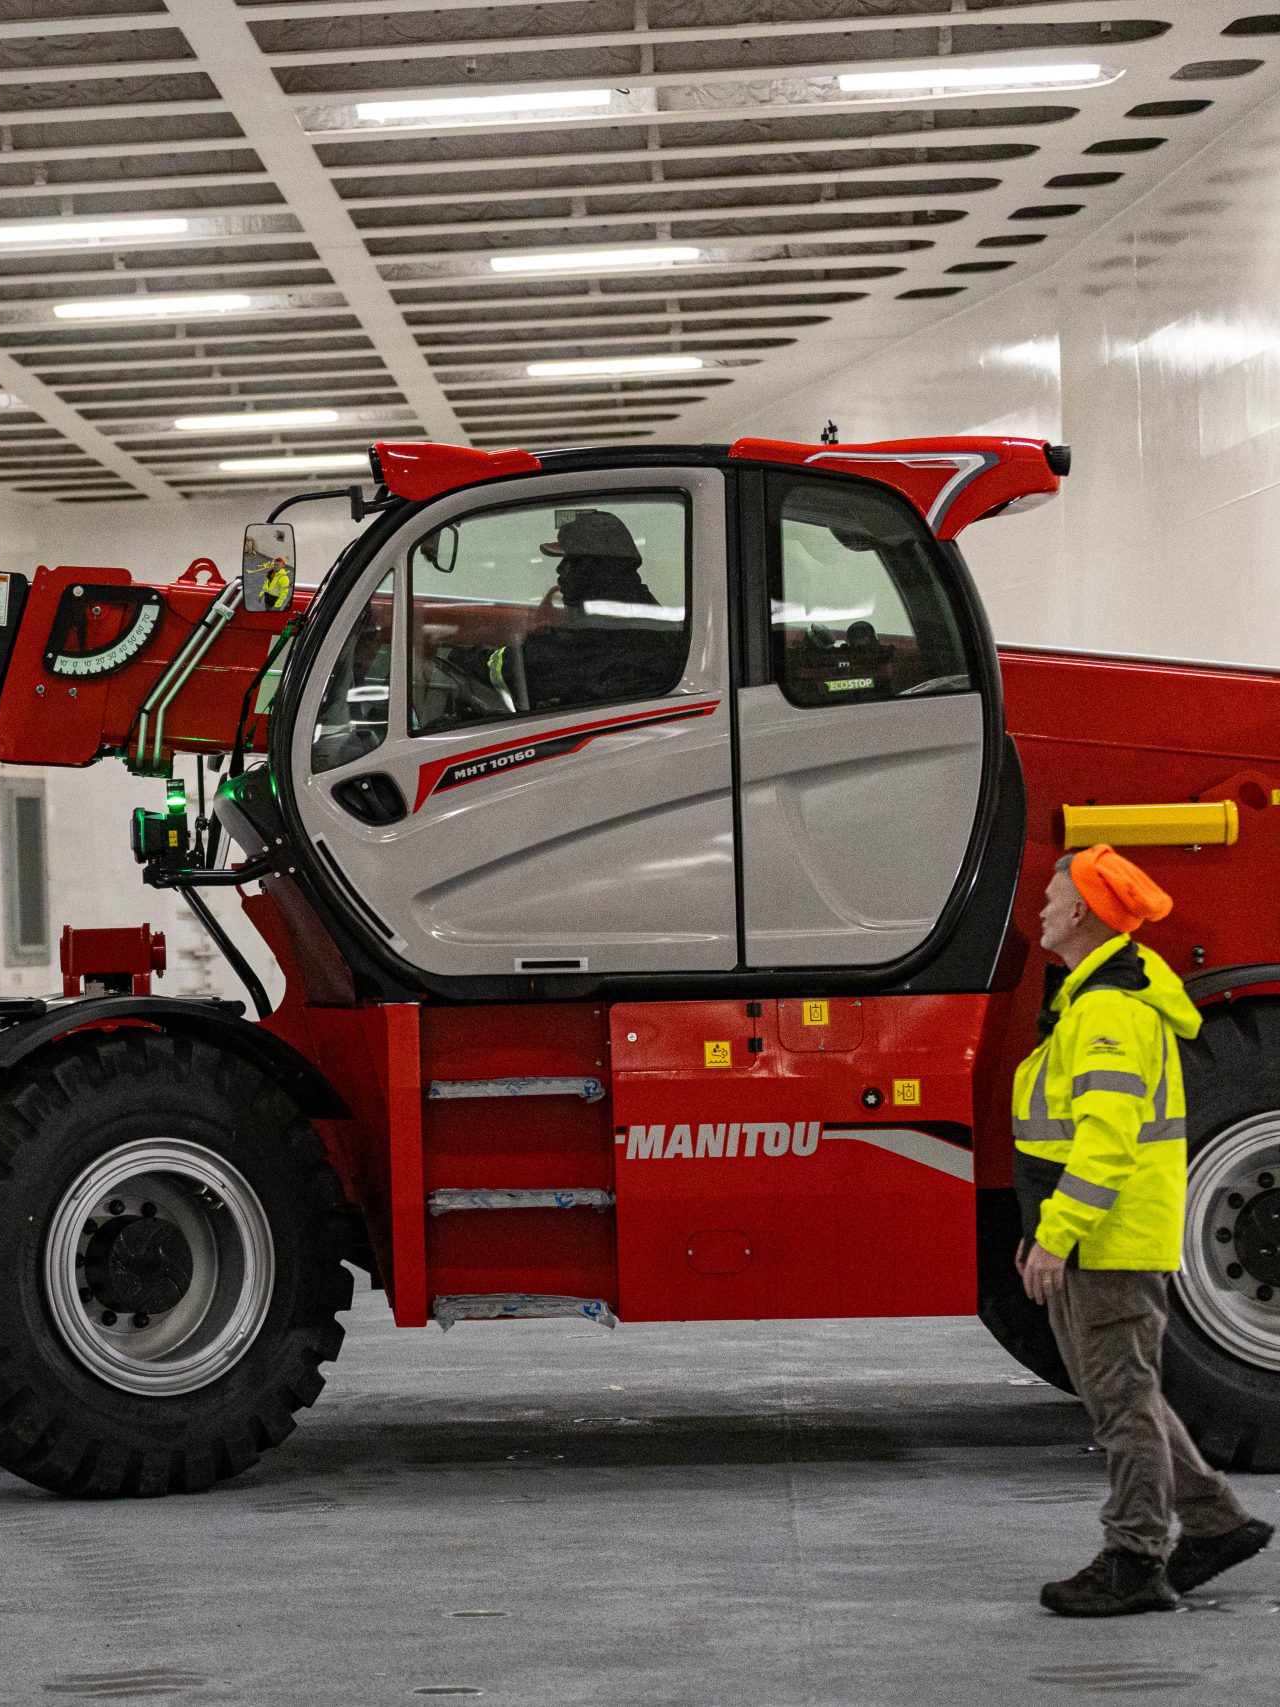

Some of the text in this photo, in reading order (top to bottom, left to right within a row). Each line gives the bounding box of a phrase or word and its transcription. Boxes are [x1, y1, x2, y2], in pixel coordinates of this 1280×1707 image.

[830, 678, 872, 690] ECOSTOP
[454, 748, 536, 780] MHT 10160
[625, 1121, 821, 1160] MANITOU
